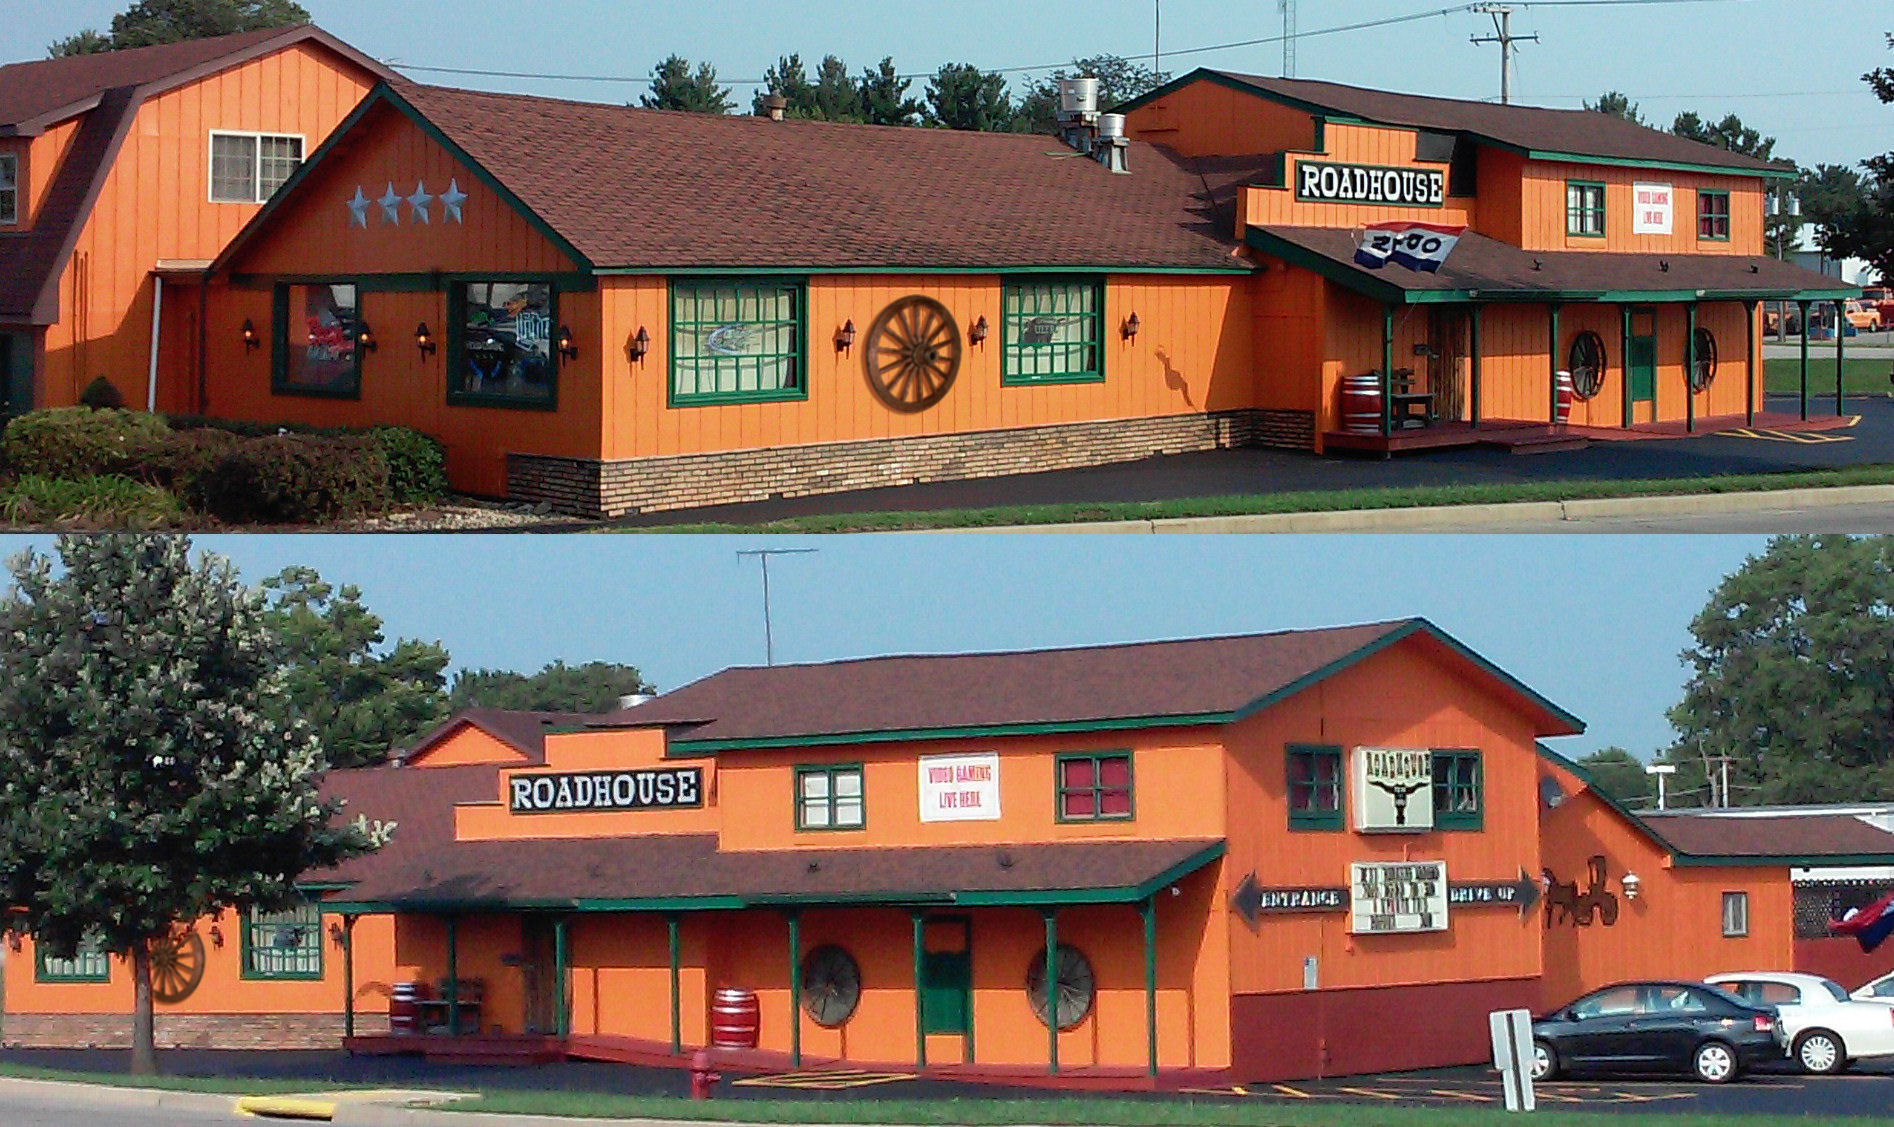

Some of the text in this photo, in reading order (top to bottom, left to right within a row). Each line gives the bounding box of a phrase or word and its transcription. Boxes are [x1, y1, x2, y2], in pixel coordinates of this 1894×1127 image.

[1301, 164, 1443, 202] ROADHOUSE
[510, 770, 697, 810] ROADHOUSE
[1260, 889, 1341, 908] ENTRANCE
[1450, 886, 1493, 903] DRIVE
[1497, 885, 1516, 901] UP
